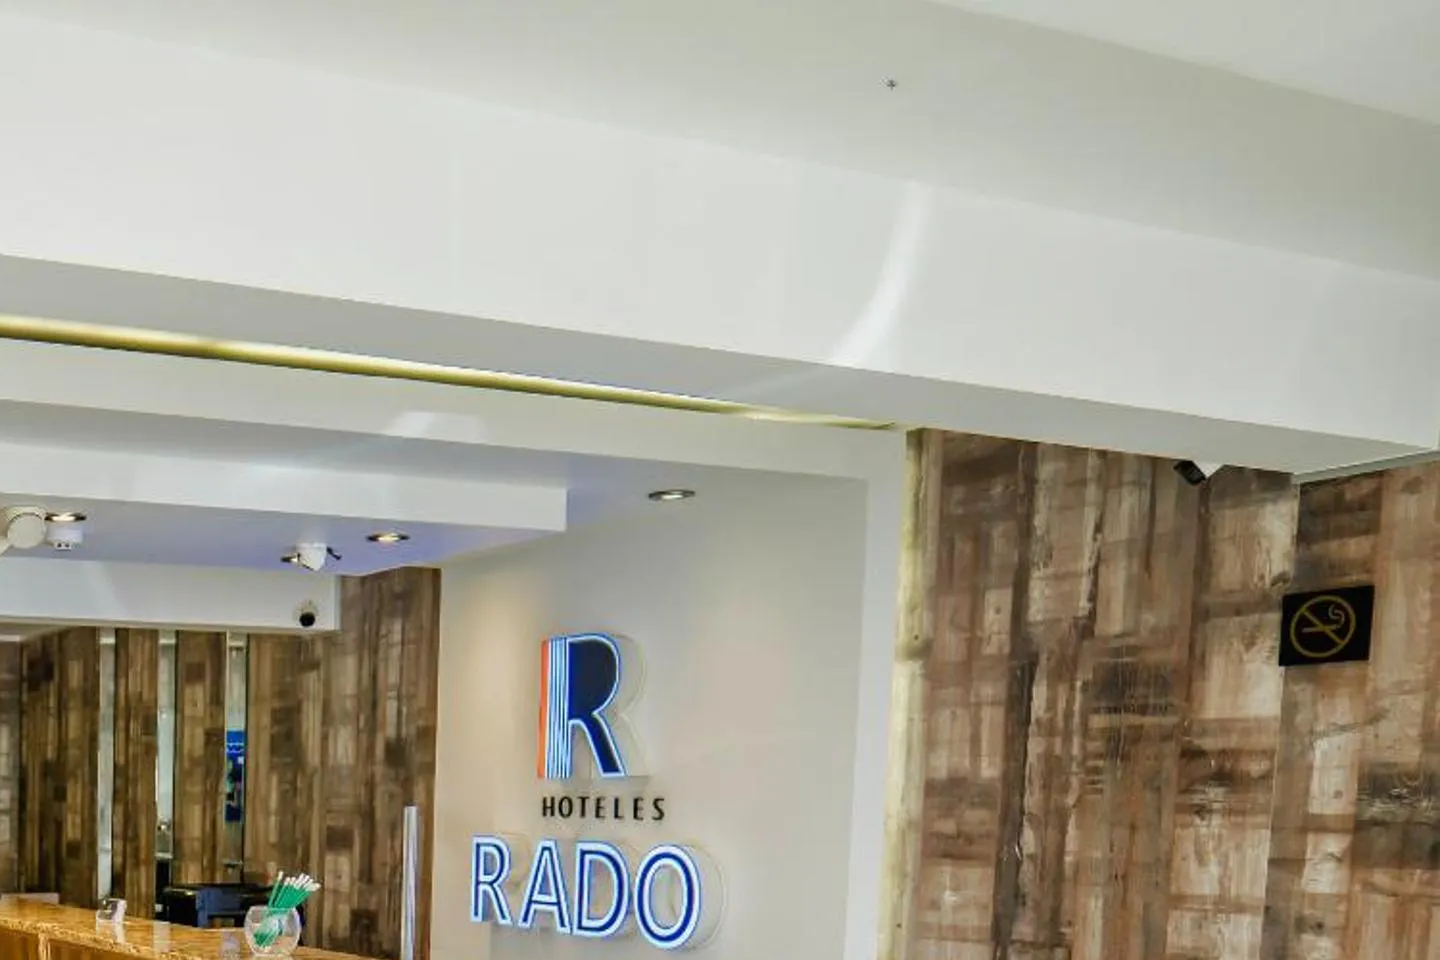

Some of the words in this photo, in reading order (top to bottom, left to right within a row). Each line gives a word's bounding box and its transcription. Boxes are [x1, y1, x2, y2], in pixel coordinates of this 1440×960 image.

[537, 633, 627, 779] R
[542, 796, 666, 821] HOTELES
[470, 835, 701, 949] RADO
